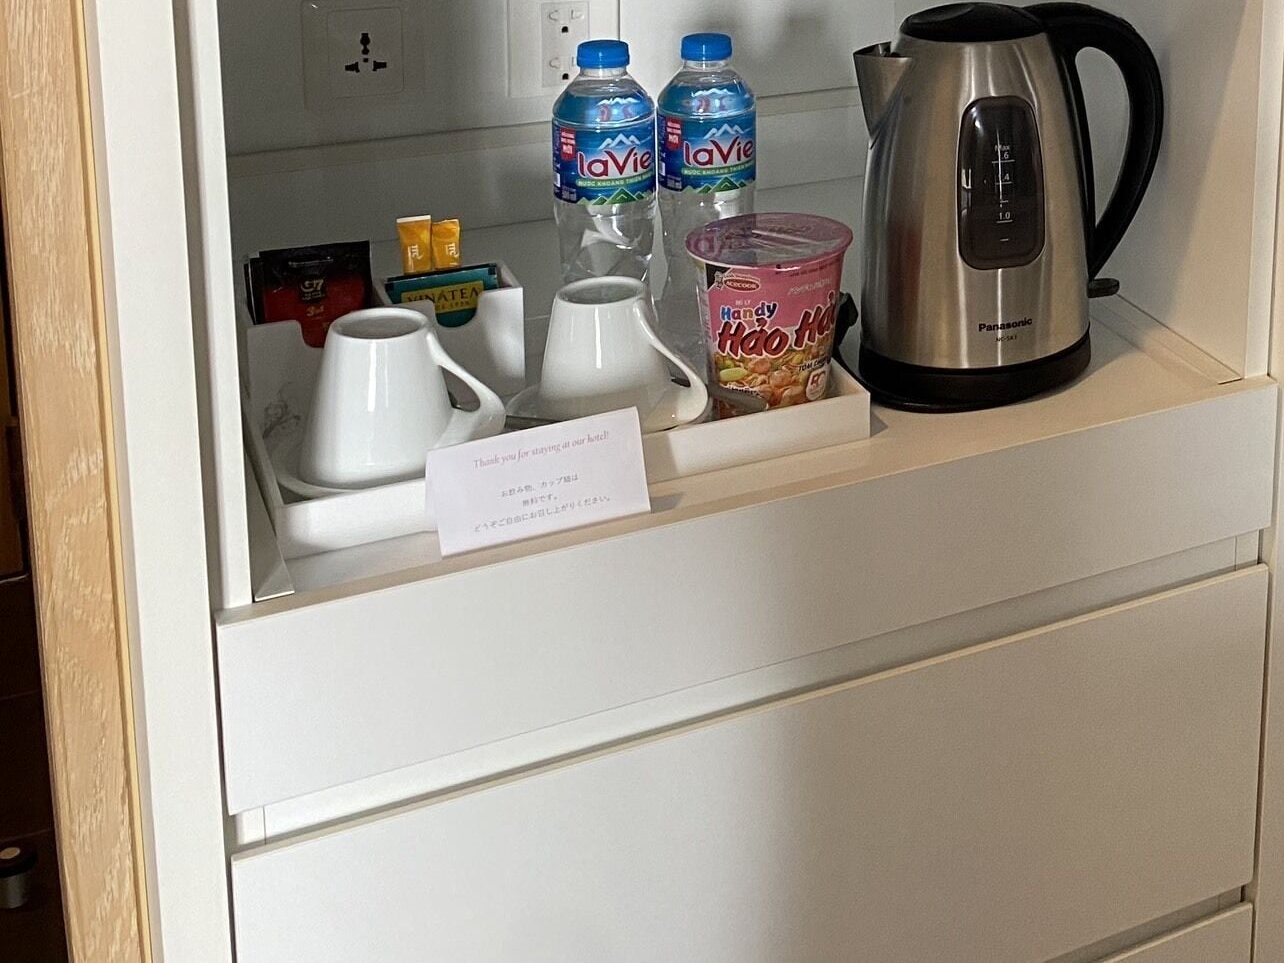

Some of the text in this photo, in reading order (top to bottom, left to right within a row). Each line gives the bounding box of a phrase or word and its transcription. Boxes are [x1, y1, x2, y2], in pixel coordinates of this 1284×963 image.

[578, 146, 652, 177] laVie
[684, 135, 753, 166] laVie
[998, 211, 1011, 220] 1.0
[300, 278, 324, 292] G7
[720, 301, 778, 321] Handy
[717, 290, 836, 358] Hảo Hả
[978, 317, 1033, 332] Panasonic
[473, 430, 609, 470] Thank you for staying at our hotel!
